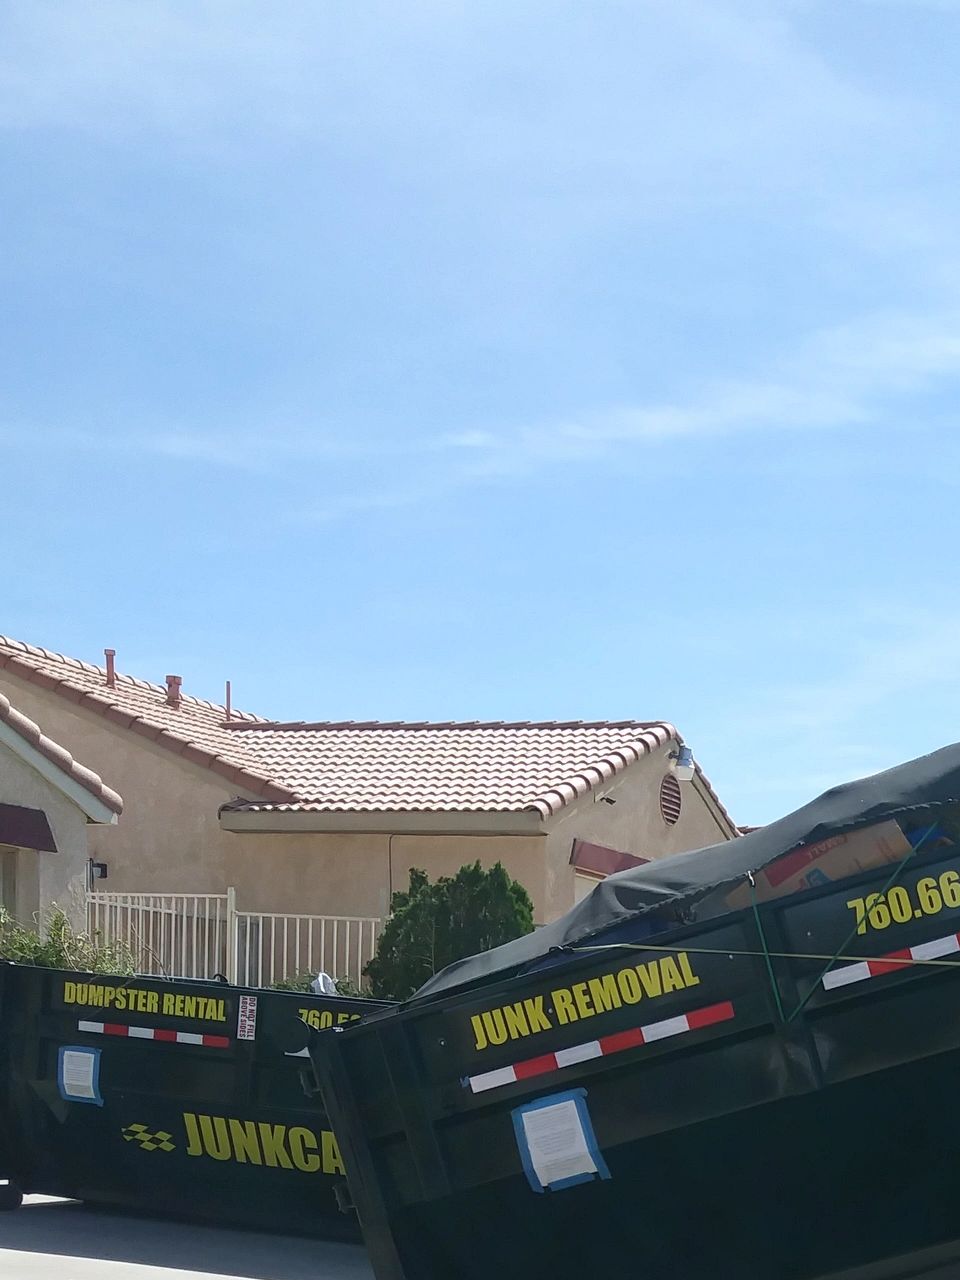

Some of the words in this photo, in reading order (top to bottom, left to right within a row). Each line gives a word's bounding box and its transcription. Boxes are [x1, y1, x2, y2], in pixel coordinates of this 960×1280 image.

[64, 982, 160, 1014] DUMPSTER
[162, 992, 226, 1022] RENTAL
[240, 996, 248, 1018] ABOVE
[249, 997, 256, 1007] DO
[470, 995, 552, 1051] JUNK
[550, 951, 700, 1025] REMOVAL
[239, 1018, 247, 1038] SIDES
[246, 1024, 254, 1038] FILL
